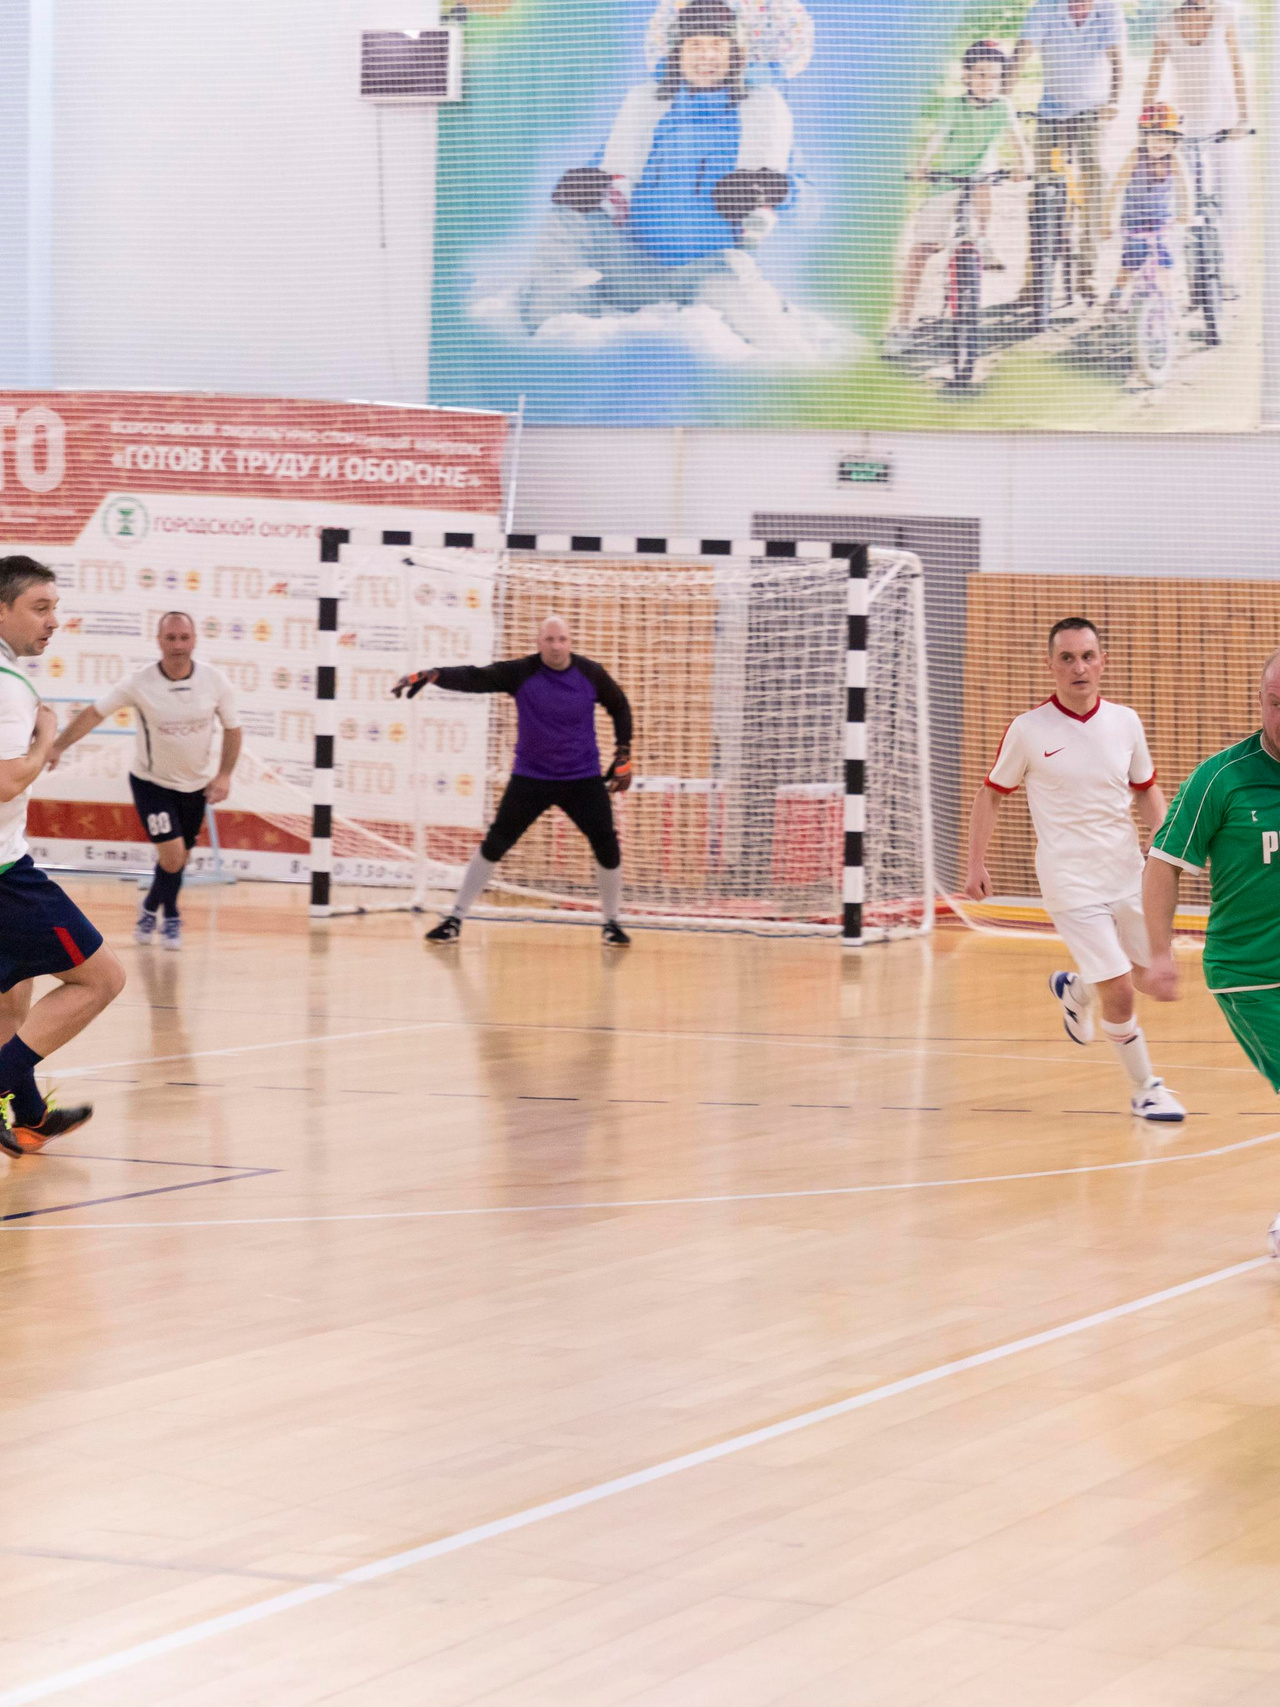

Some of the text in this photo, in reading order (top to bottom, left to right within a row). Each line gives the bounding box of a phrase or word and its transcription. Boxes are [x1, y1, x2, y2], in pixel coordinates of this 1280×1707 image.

[209, 447, 229, 473] К
[234, 449, 315, 481] ТРУДУ
[319, 455, 340, 480] И
[153, 516, 255, 536] ГОРОДСКОЙ
